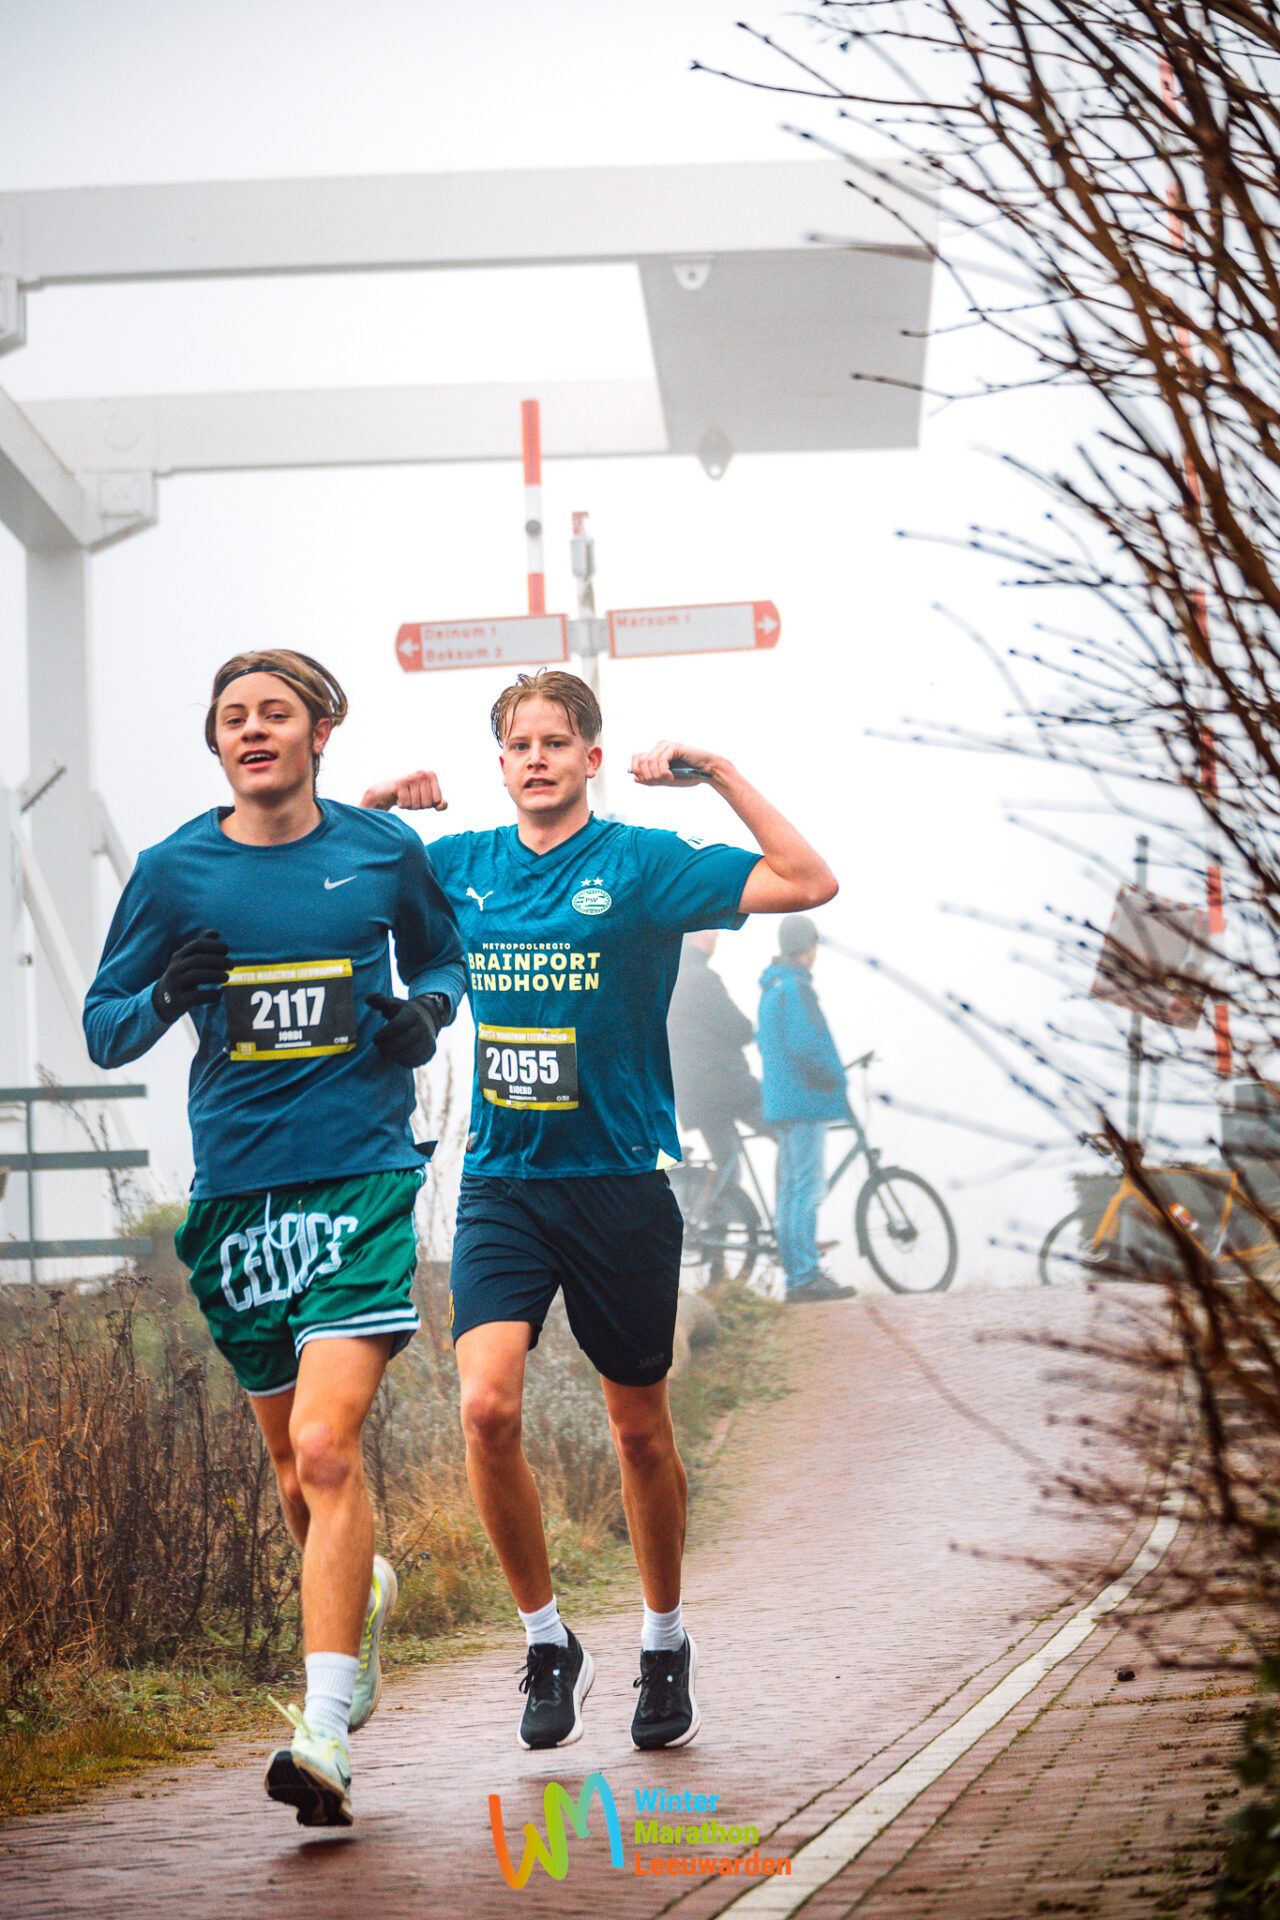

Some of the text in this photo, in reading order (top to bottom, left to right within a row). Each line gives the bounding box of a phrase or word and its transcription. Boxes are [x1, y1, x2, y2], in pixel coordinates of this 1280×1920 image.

[425, 627, 485, 641] Deinum
[467, 952, 601, 971] BRAINPORT
[471, 972, 600, 992] EINDHOVEN
[250, 986, 326, 1030] 2117
[486, 1046, 560, 1085] 2055
